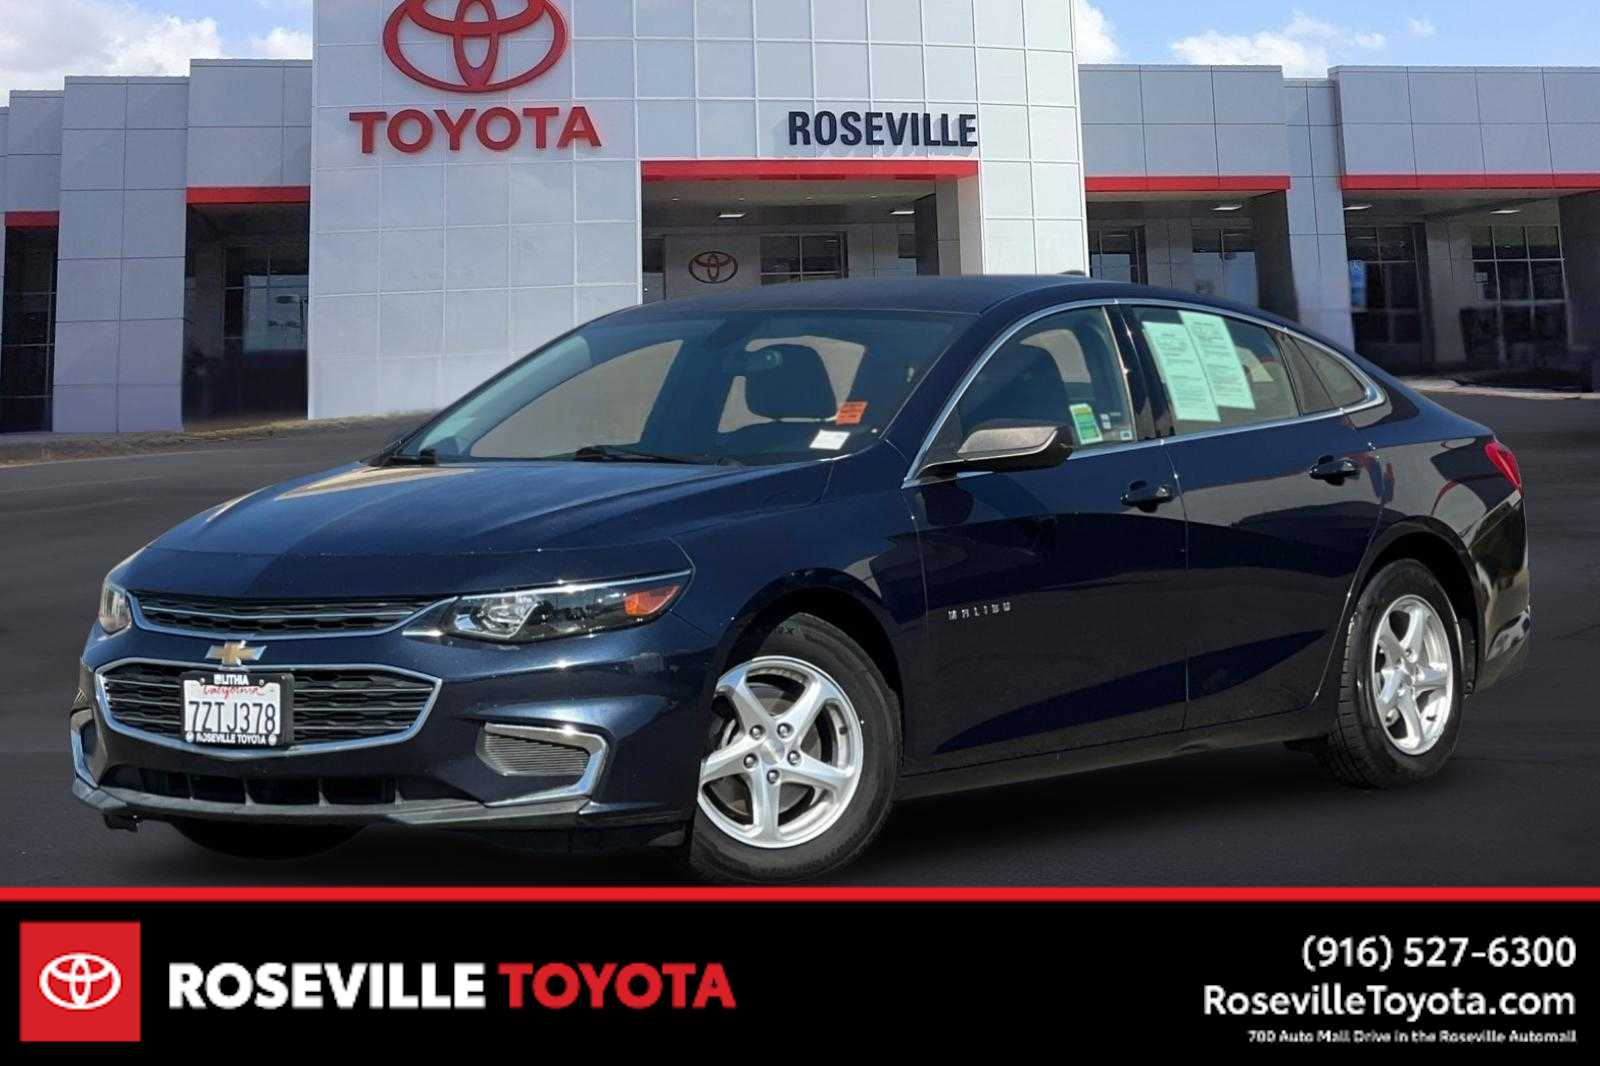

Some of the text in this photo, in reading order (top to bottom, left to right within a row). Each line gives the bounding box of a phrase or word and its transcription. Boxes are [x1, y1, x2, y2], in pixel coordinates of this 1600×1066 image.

[350, 106, 602, 153] TOYOTA
[789, 110, 978, 147] ROSEVILLE
[947, 600, 1012, 620] MALIBU
[188, 701, 275, 733] 7ZTJ378
[196, 732, 267, 744] ROSEVILLE TOYOTA
